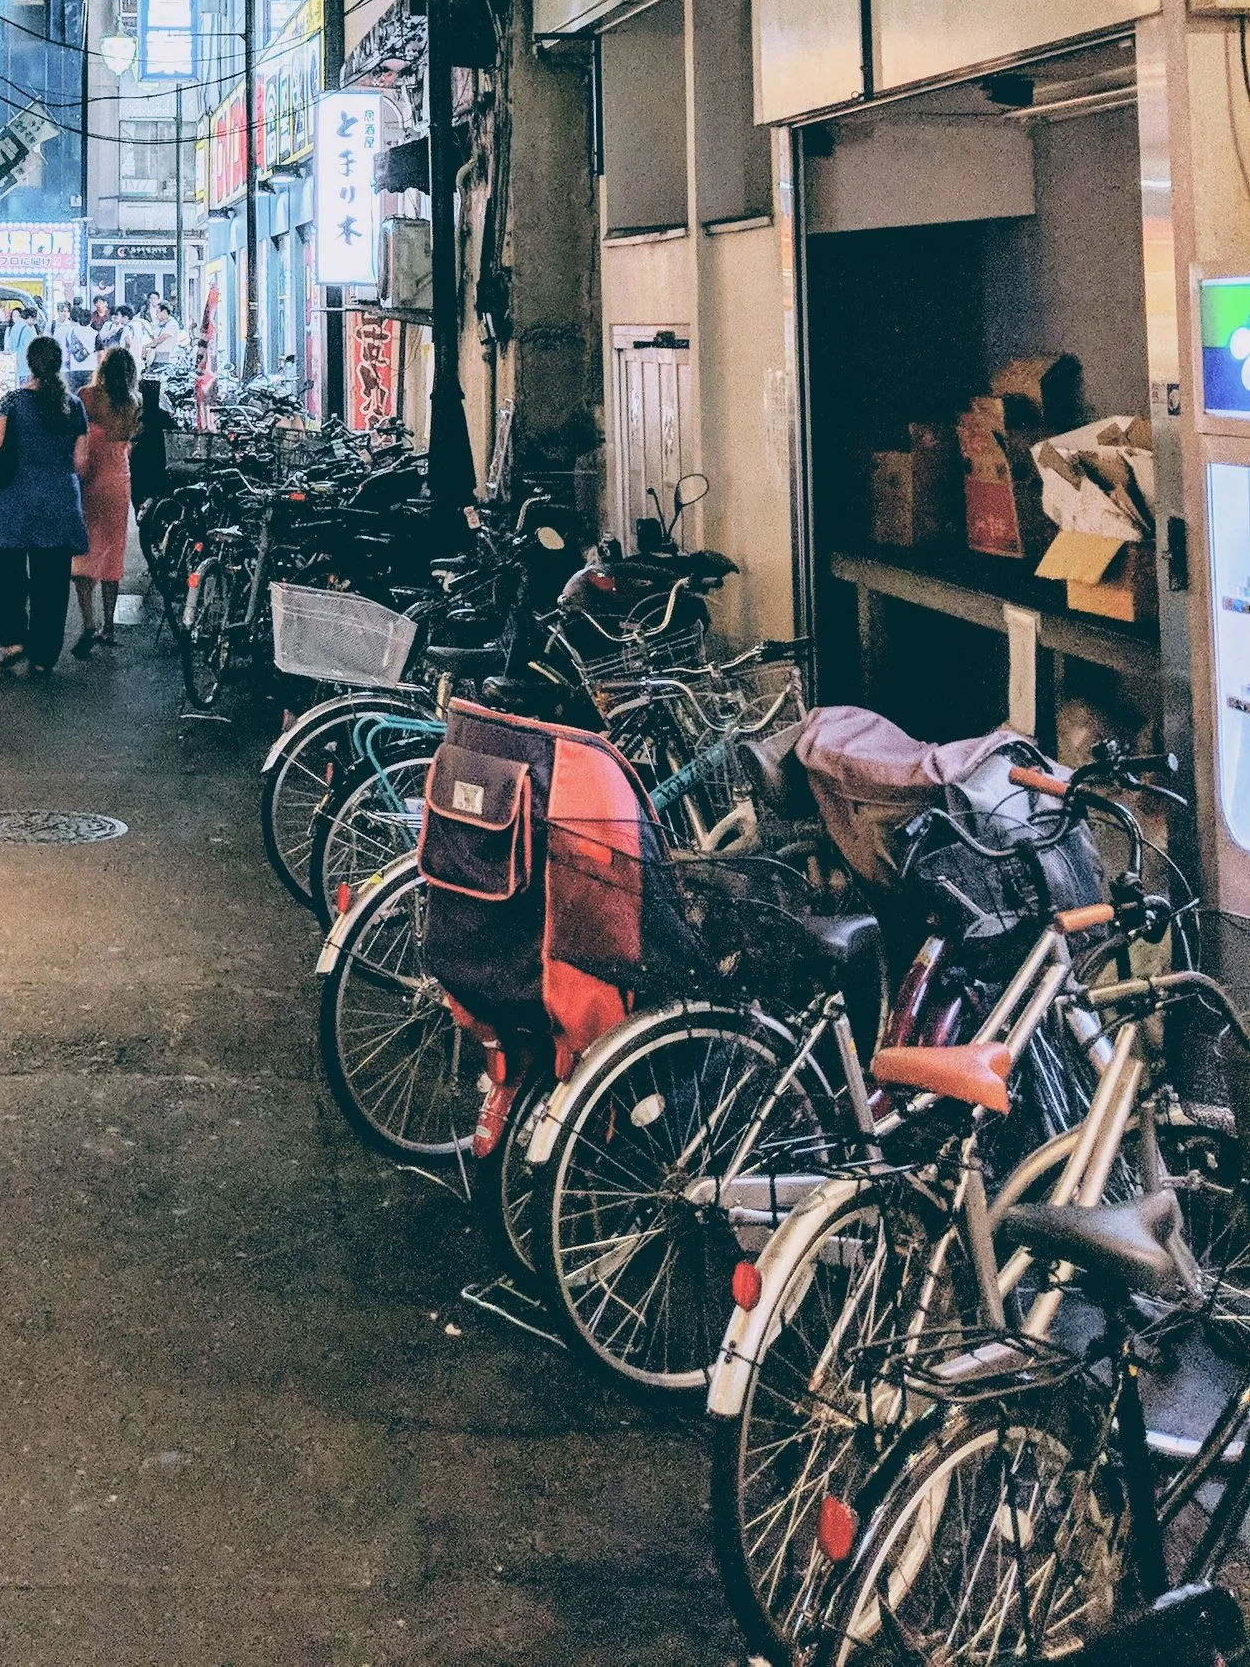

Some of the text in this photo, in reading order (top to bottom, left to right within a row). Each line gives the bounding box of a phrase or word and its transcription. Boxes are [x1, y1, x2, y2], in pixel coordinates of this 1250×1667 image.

[364, 109, 375, 149] 居酒屋
[336, 110, 363, 246] とまり木
